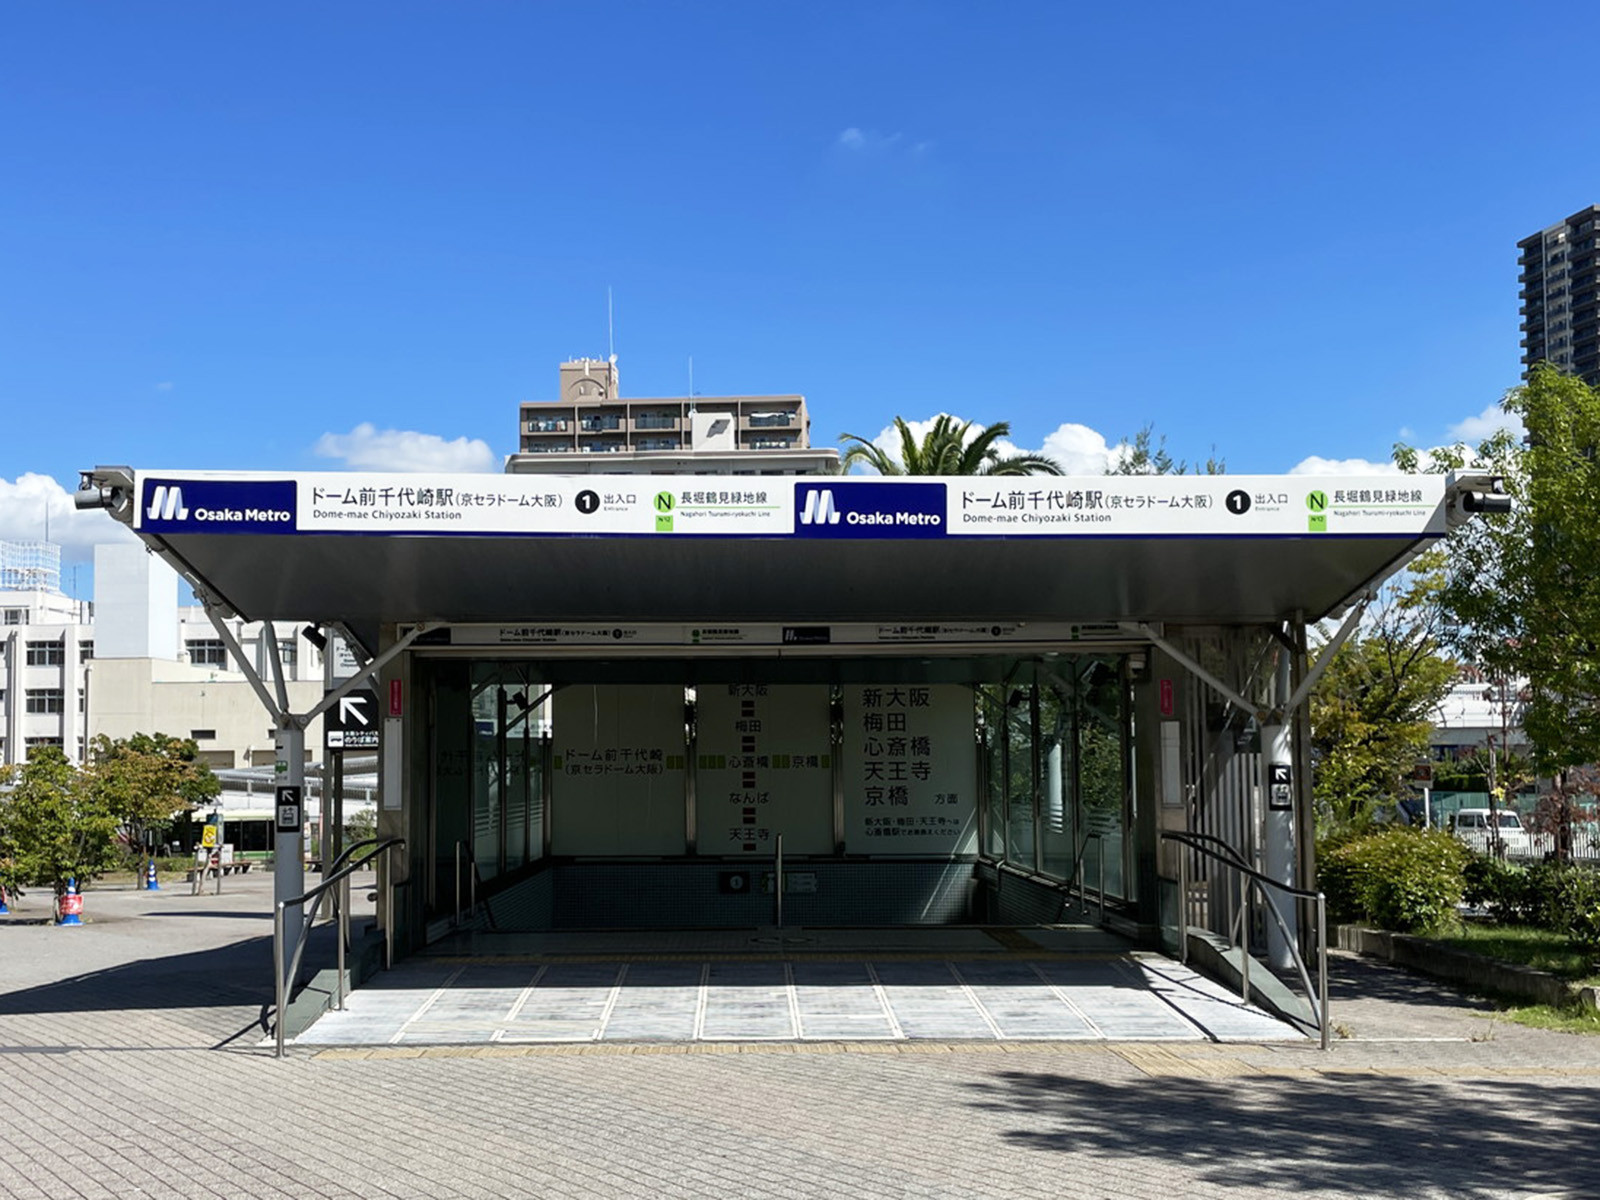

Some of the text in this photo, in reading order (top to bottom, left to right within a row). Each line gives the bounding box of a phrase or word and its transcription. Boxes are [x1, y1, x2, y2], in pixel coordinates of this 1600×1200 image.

[603, 493, 637, 504] 出入口
[657, 494, 672, 510] N
[681, 491, 768, 504] 長堀鶴見緑地線
[1254, 493, 1289, 504] 出入口
[1310, 493, 1324, 509] N
[1334, 490, 1423, 503] 長堀鶴見緑地線
[194, 508, 291, 522] Osaka Metro
[313, 509, 462, 521] Dome-mae Chiyozaki Station
[846, 511, 941, 525] Osaka Metro
[963, 513, 1112, 524] Dome-mae Chiyozaki Station
[728, 683, 768, 697] 新大阪
[863, 687, 930, 708] 新大阪
[735, 720, 761, 732] 梅田
[863, 713, 906, 732] 梅田
[864, 736, 931, 757] 心斎橋
[565, 749, 663, 761] ドーム前千代崎
[728, 755, 769, 768] 心斎橋
[792, 755, 818, 768] 京橋
[864, 761, 931, 781] 天王寺
[729, 792, 770, 804] なんば
[864, 785, 958, 806] 京橋 方面
[729, 828, 770, 841] 天王寺
